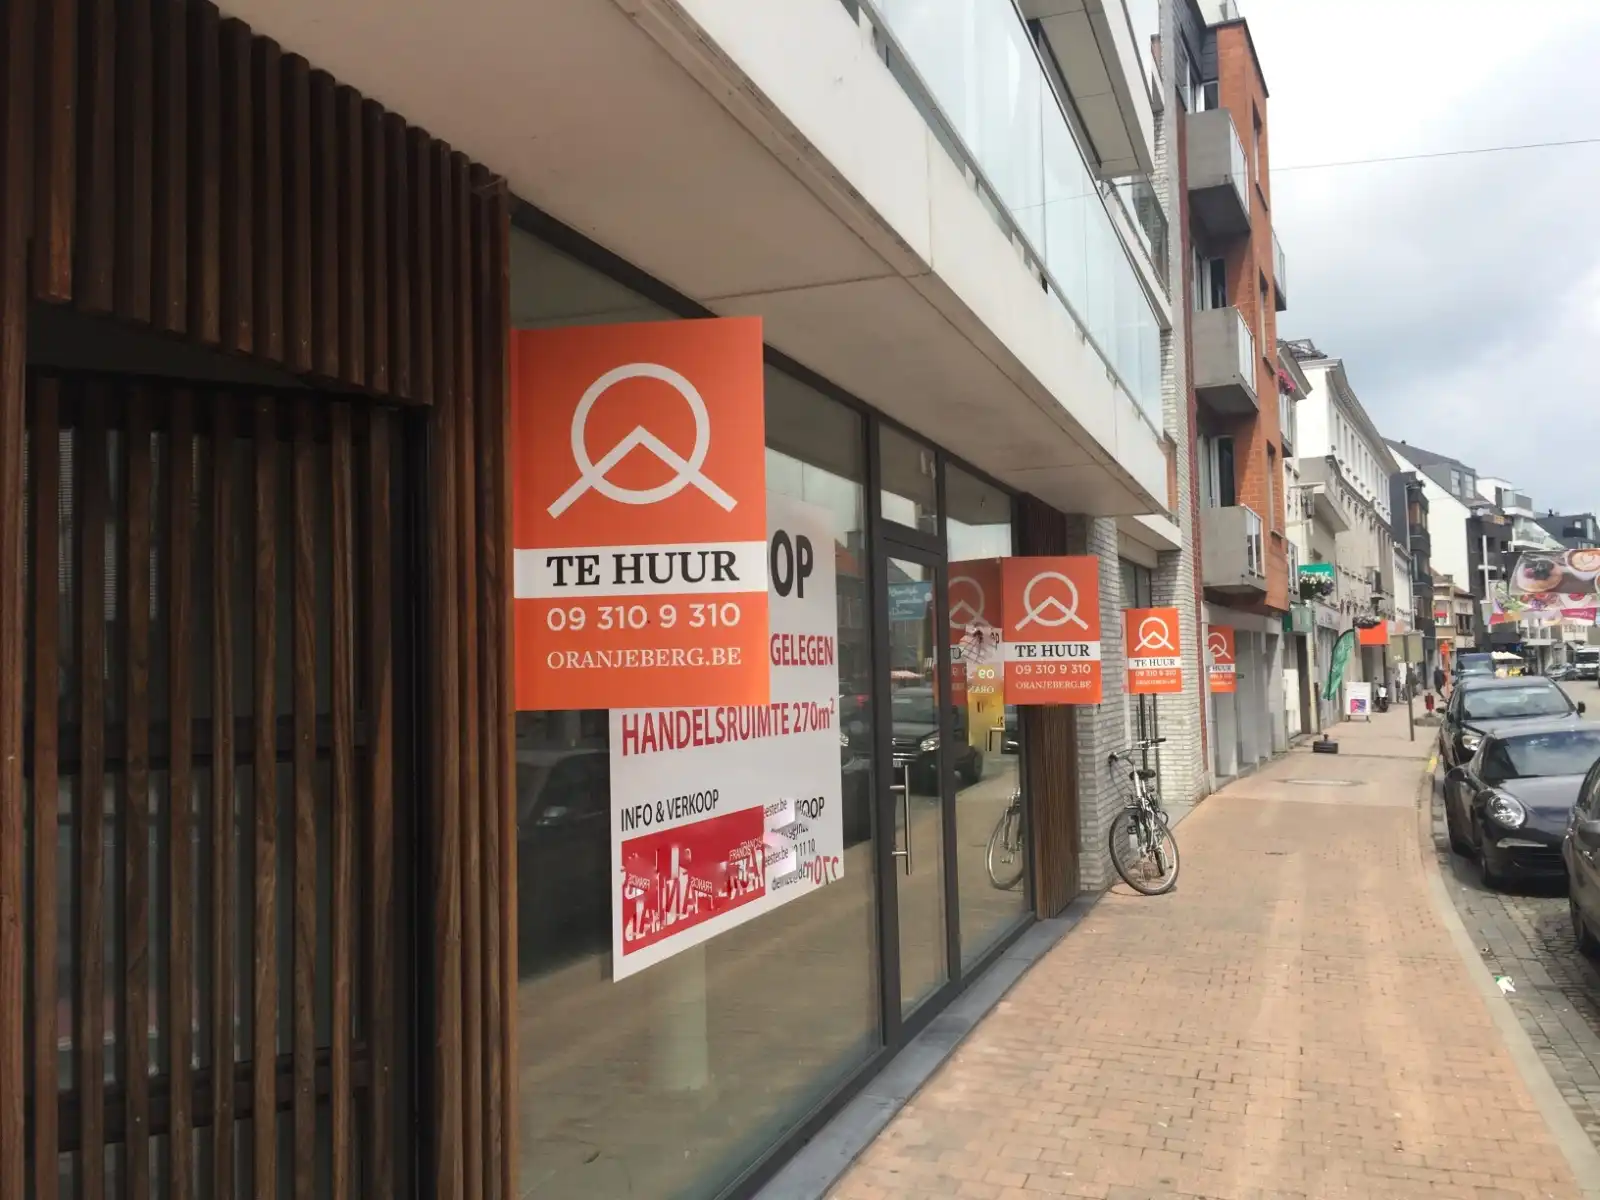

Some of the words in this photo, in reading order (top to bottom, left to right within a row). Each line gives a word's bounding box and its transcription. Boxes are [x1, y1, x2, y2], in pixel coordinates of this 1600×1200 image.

[546, 554, 600, 587] TE
[612, 550, 740, 585] HUUR
[769, 529, 813, 598] OP
[546, 606, 586, 631] 09
[596, 604, 648, 631] 310
[659, 603, 677, 629] 9
[688, 602, 741, 628] 310
[546, 647, 742, 670] ORANJEBERG.BE
[770, 633, 834, 666] GELEGEN
[1015, 644, 1037, 657] TE
[1041, 643, 1090, 657] HUUR
[1135, 659, 1147, 667] TE
[1149, 658, 1176, 667] HUUR
[1015, 664, 1032, 675] 09
[1035, 664, 1056, 674] 310
[1060, 664, 1067, 674] 9
[1071, 663, 1091, 674] 310
[1015, 680, 1092, 690] ORANJEBERG.BE
[621, 703, 790, 757] HANDELSRUIMTE
[621, 804, 653, 832] INFO
[655, 800, 665, 823] &
[666, 788, 720, 821] VERKOOP
